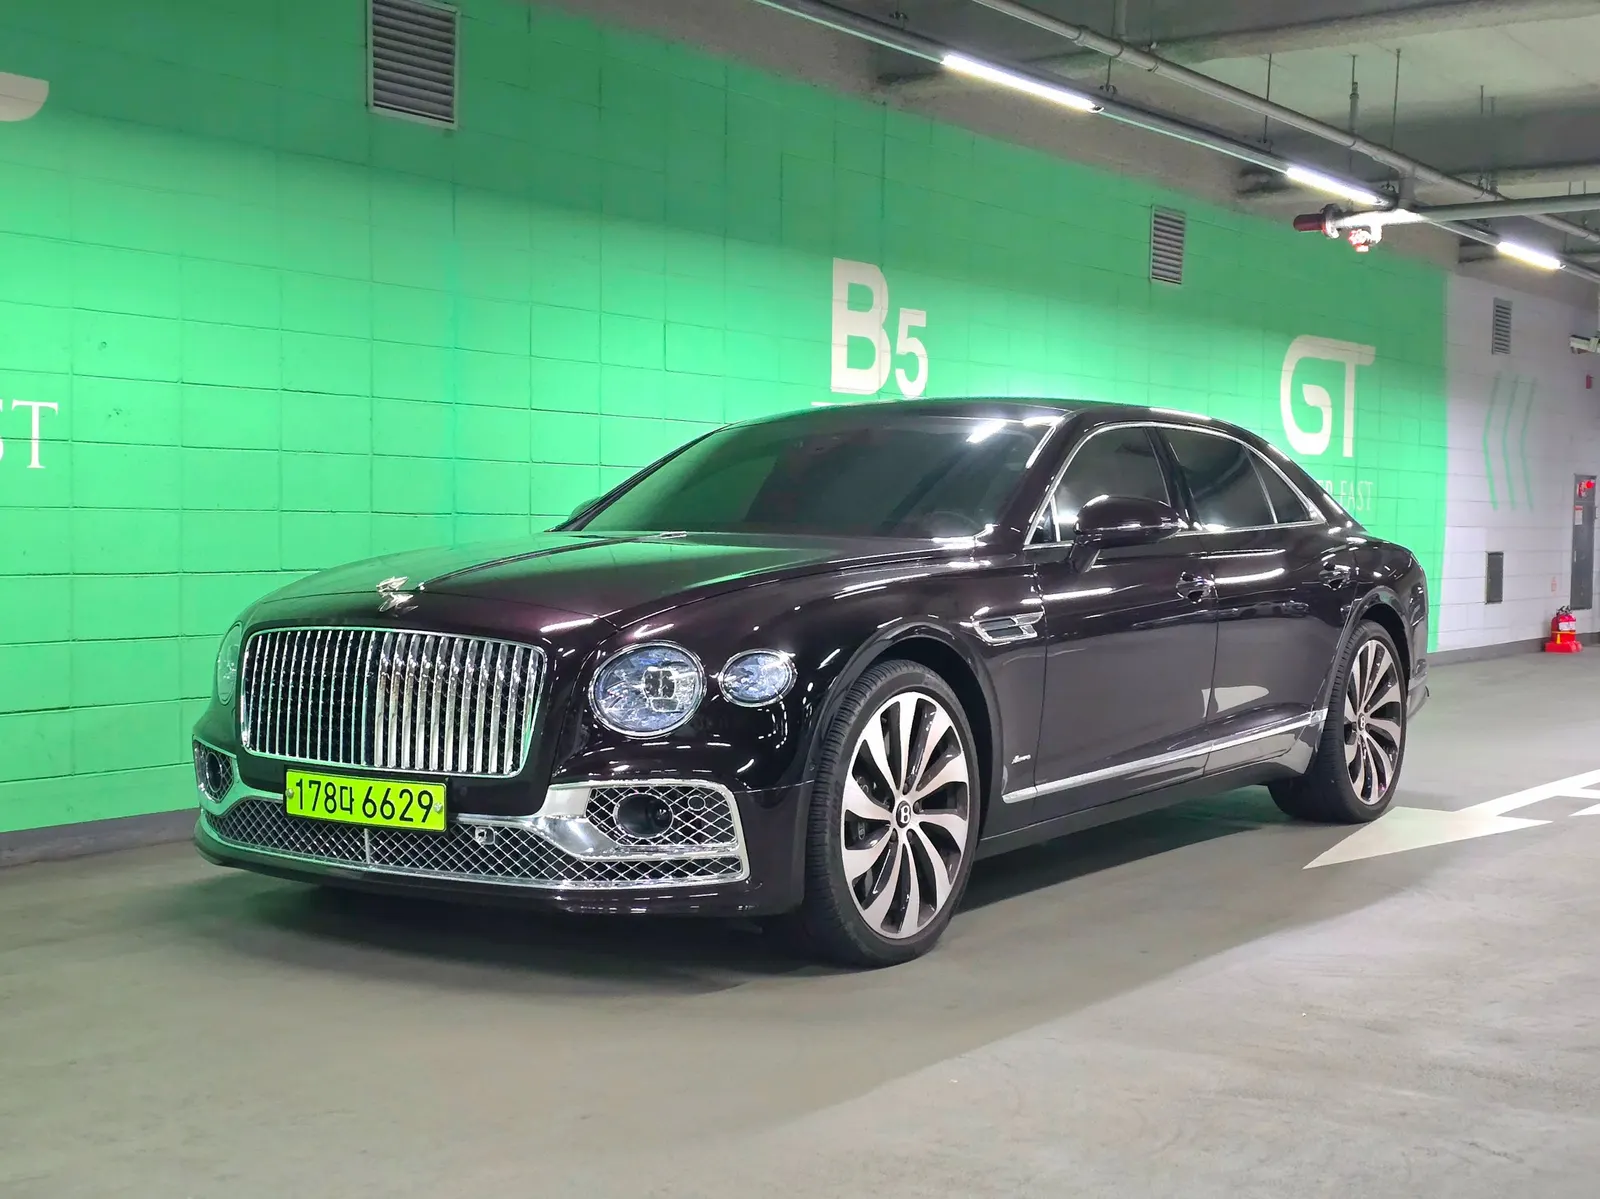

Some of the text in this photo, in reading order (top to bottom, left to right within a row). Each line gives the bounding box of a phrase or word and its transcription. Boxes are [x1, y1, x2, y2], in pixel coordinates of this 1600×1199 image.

[831, 257, 928, 398] B5
[1280, 334, 1376, 457] GT
[1340, 480, 1374, 511] FAST
[296, 778, 434, 823] 178다 6629
[900, 805, 911, 824] B
